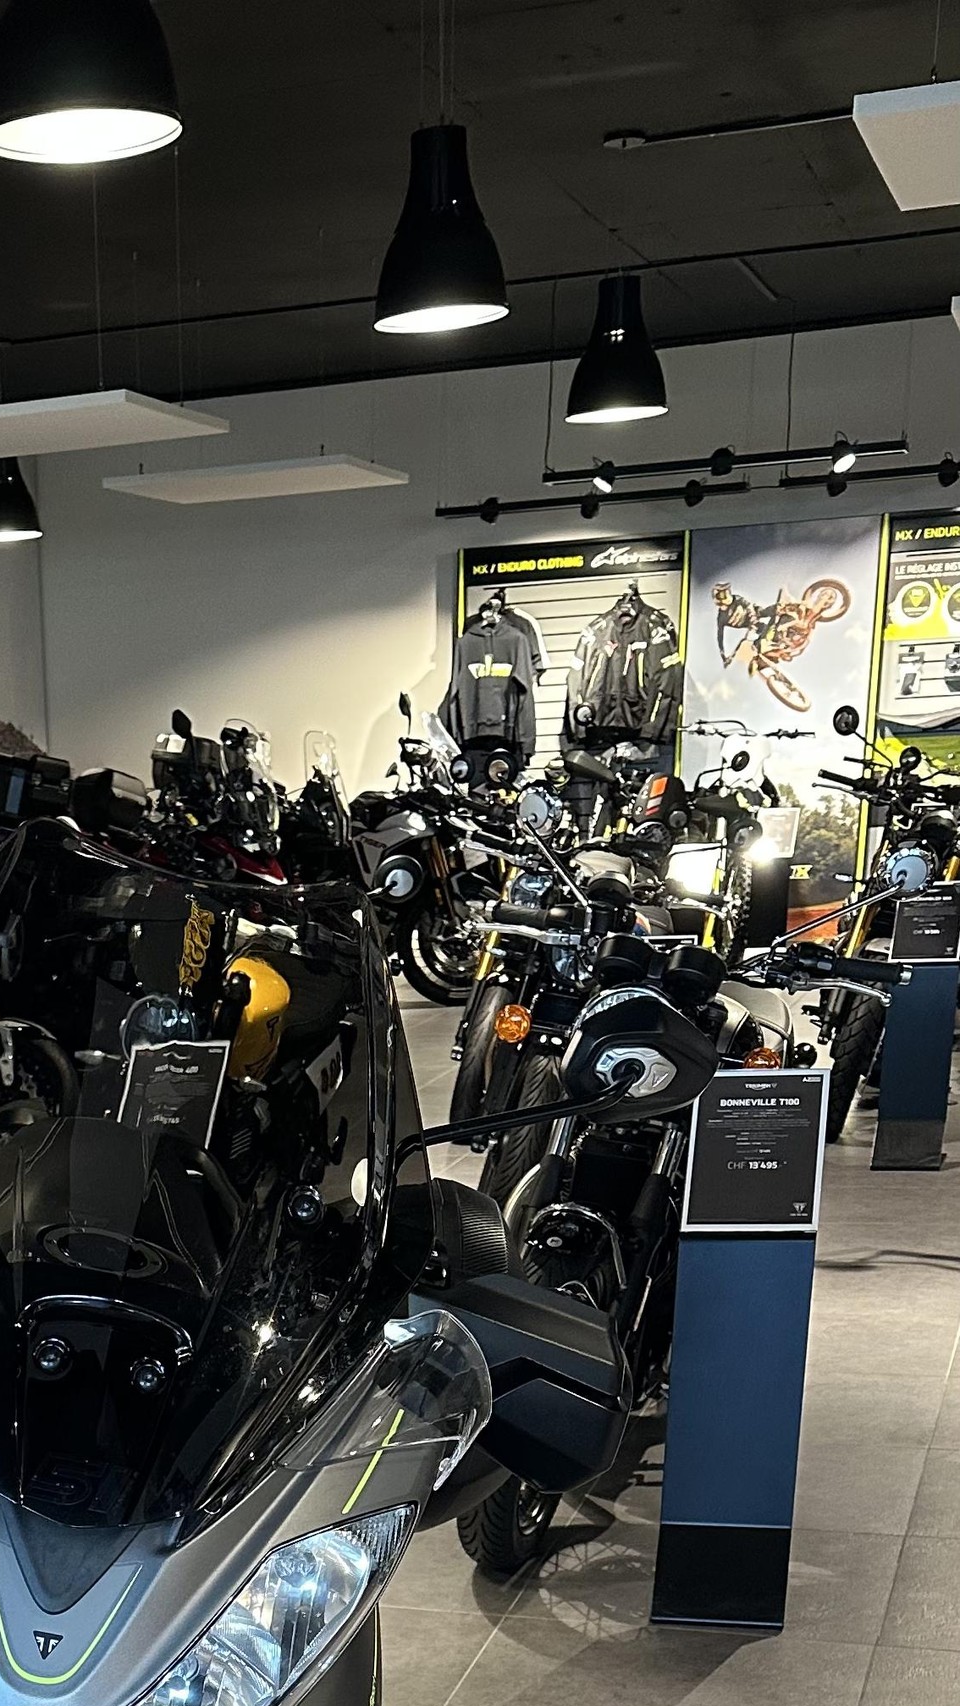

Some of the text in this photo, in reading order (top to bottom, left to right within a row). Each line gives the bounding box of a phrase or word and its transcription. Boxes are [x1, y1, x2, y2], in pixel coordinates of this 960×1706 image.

[895, 530, 914, 541] MX
[923, 526, 960, 539] ENDUR
[720, 1098, 800, 1107] BONNEVILLE T100
[727, 1161, 746, 1170] CHF
